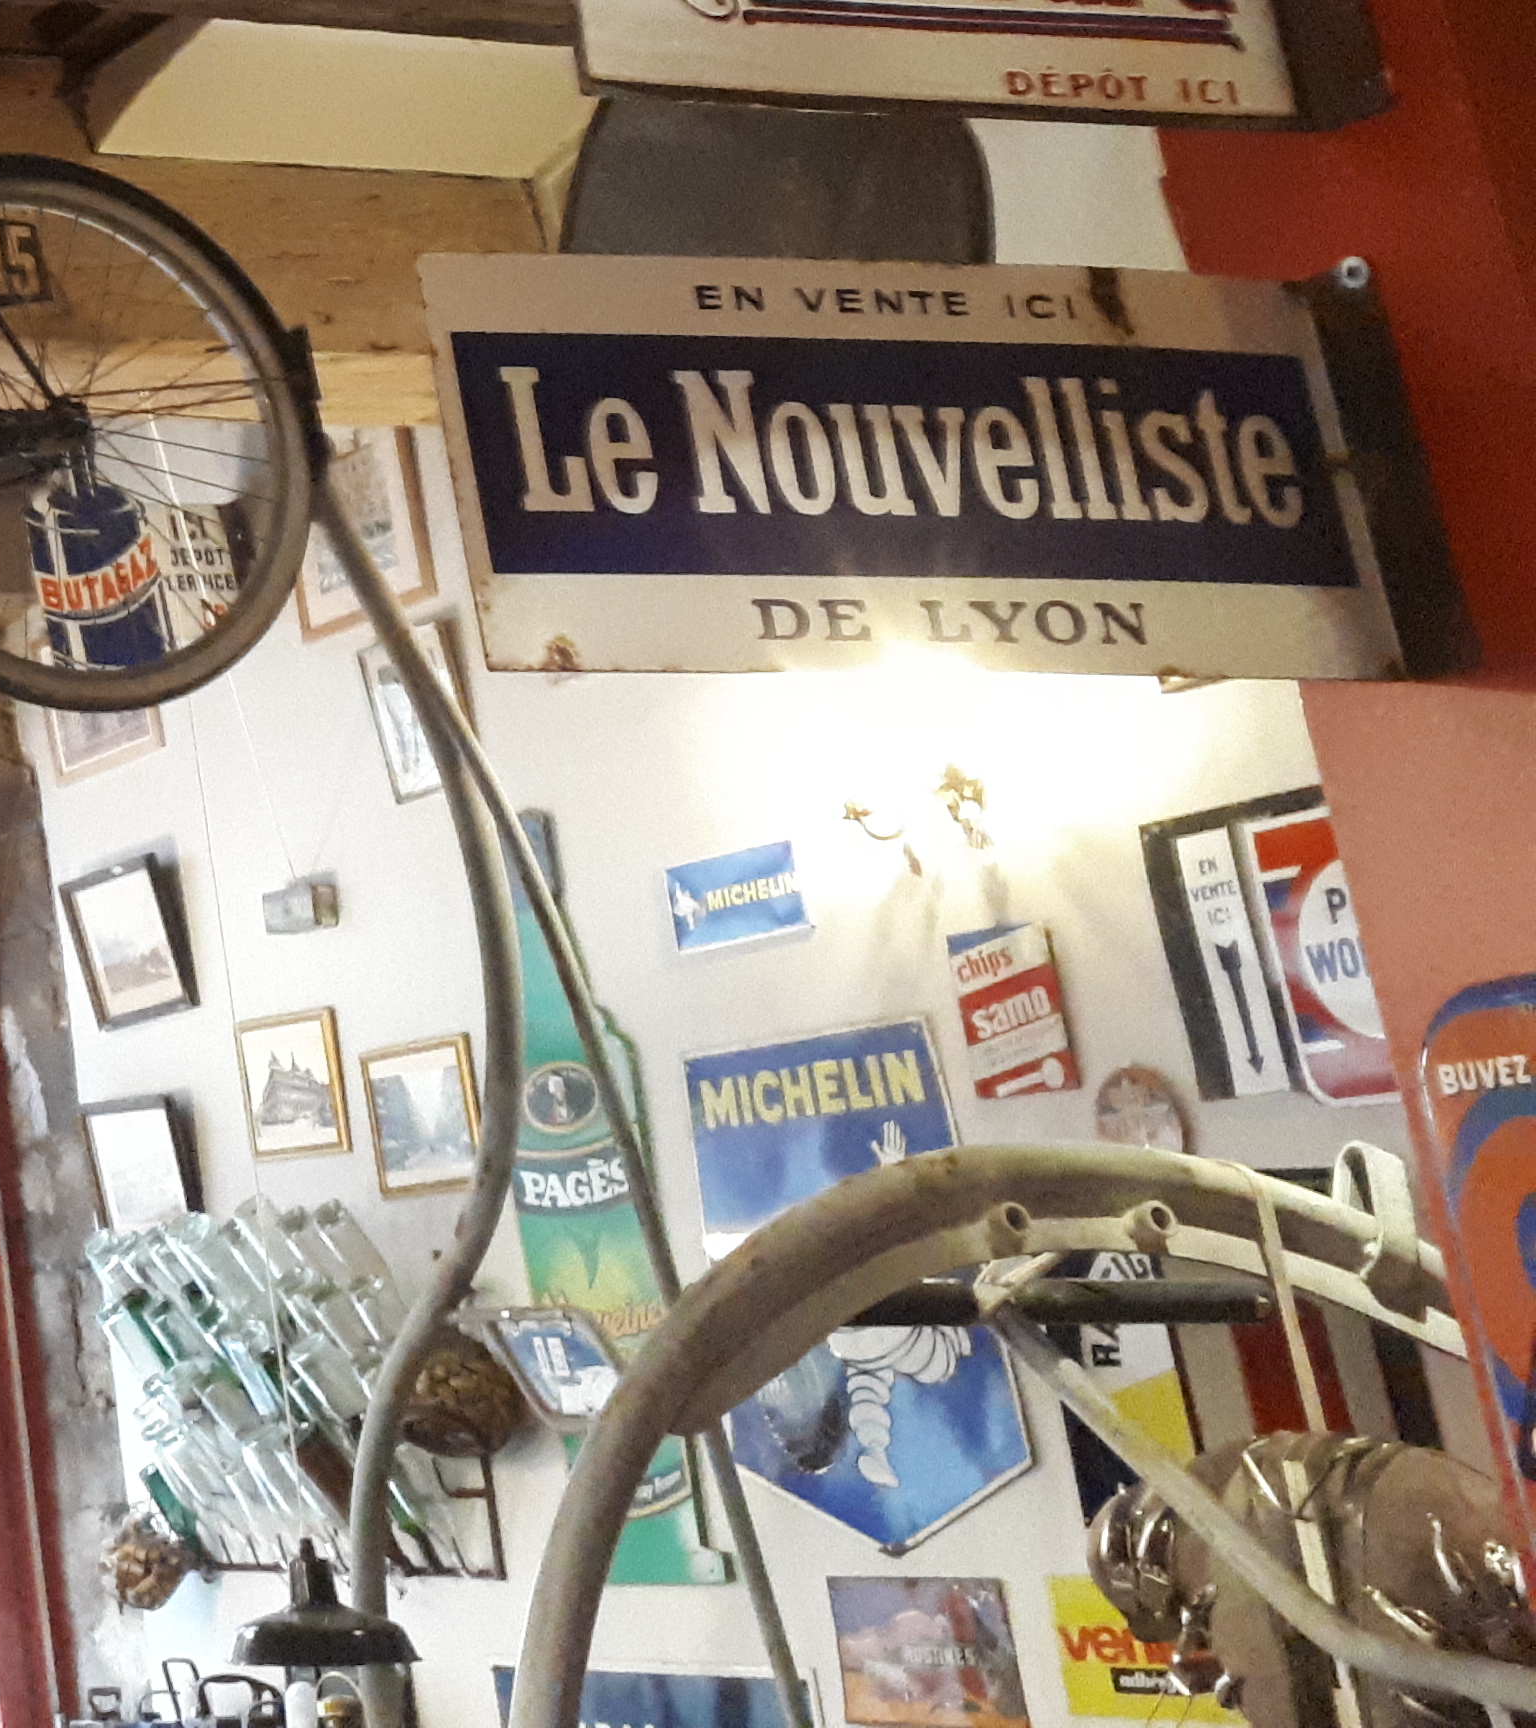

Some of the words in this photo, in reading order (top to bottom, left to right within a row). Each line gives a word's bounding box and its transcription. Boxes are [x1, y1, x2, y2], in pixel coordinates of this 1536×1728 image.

[1005, 68, 1148, 103] DÉPÔT
[1176, 77, 1239, 105] ICI
[694, 284, 766, 313] EN
[796, 287, 971, 318] VENTE
[1005, 293, 1078, 320] ICI
[500, 365, 658, 514] Le
[673, 368, 1306, 530] Nouvelliste
[40, 538, 158, 610] BUTAGAZ
[758, 598, 873, 643] DE
[923, 600, 1148, 646] LYON
[1199, 856, 1217, 876] EN
[705, 871, 801, 912] MICHELIN
[1191, 880, 1237, 902] VENTE
[1207, 908, 1230, 924] ICI
[956, 946, 1013, 983] chips
[971, 986, 1051, 1040] samo
[700, 1050, 926, 1130] MICHELIN
[1438, 1054, 1531, 1096] BUVEZ
